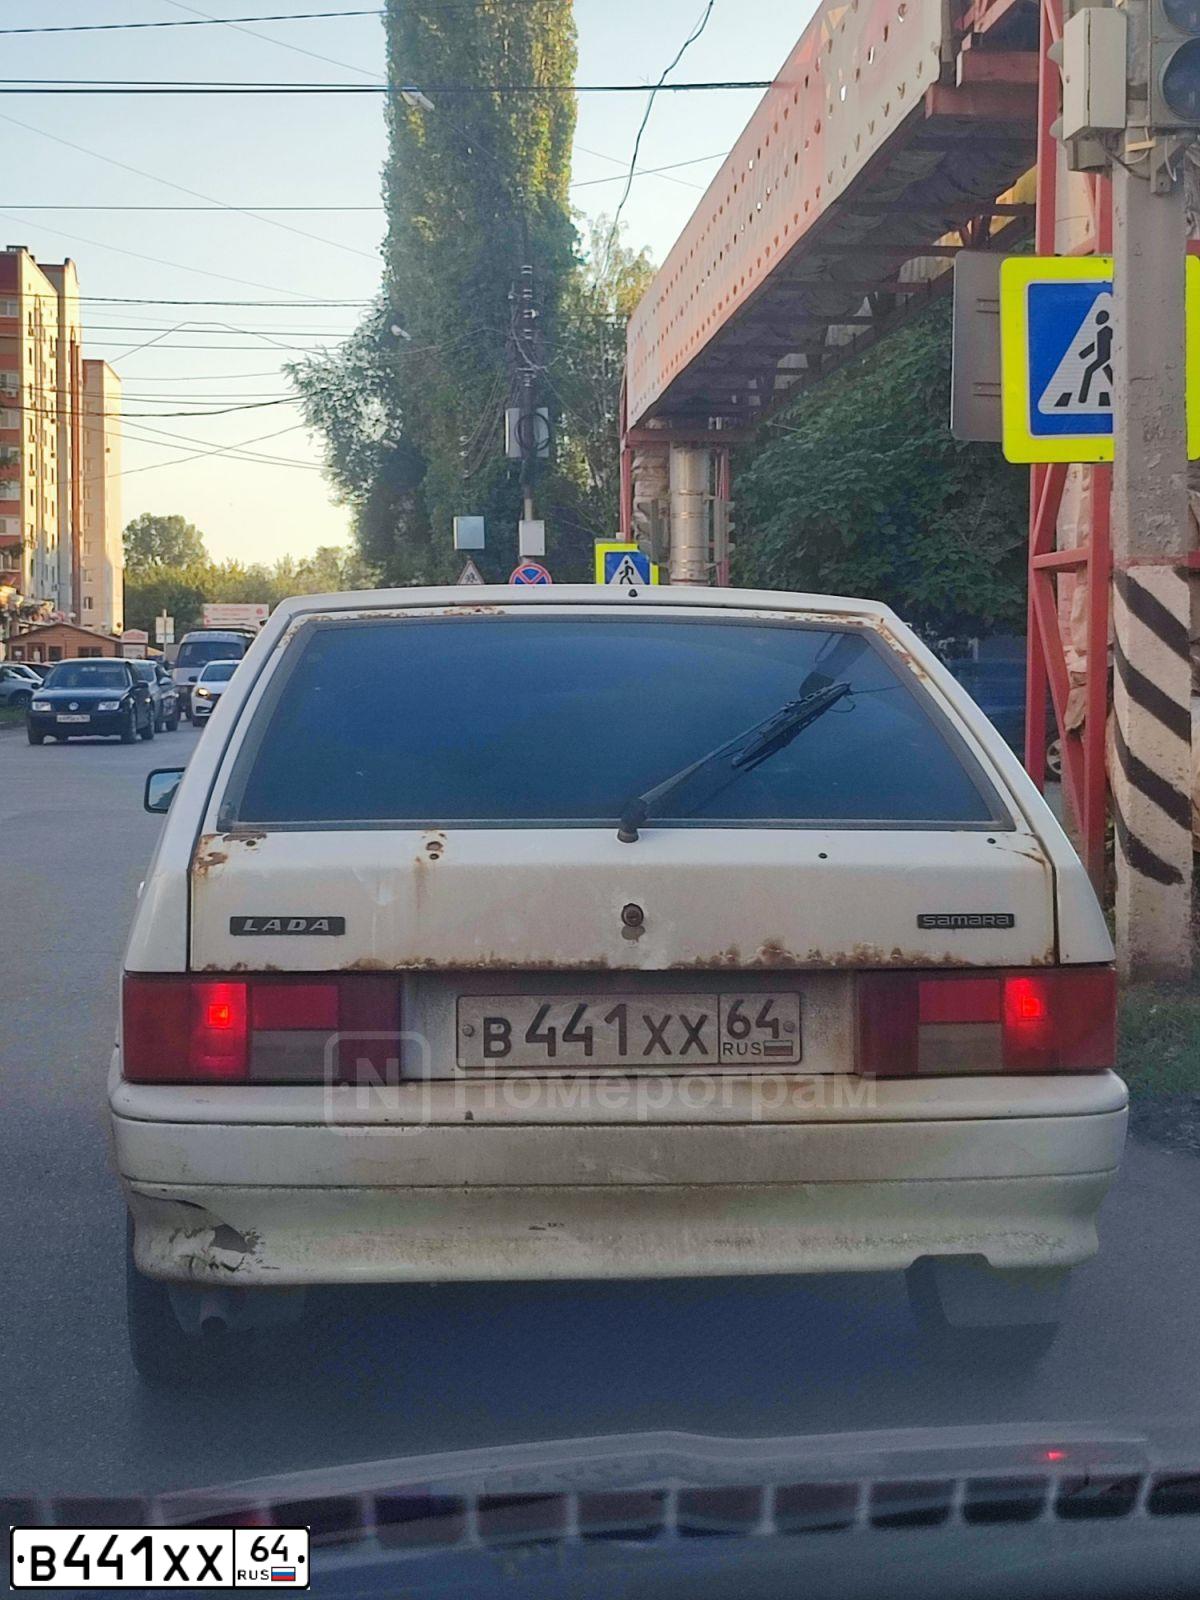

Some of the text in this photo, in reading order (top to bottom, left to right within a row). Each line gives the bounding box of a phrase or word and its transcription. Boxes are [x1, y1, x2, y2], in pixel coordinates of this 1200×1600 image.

[243, 919, 329, 931] LADA
[726, 999, 780, 1039] 64
[722, 1042, 762, 1056] RUS
